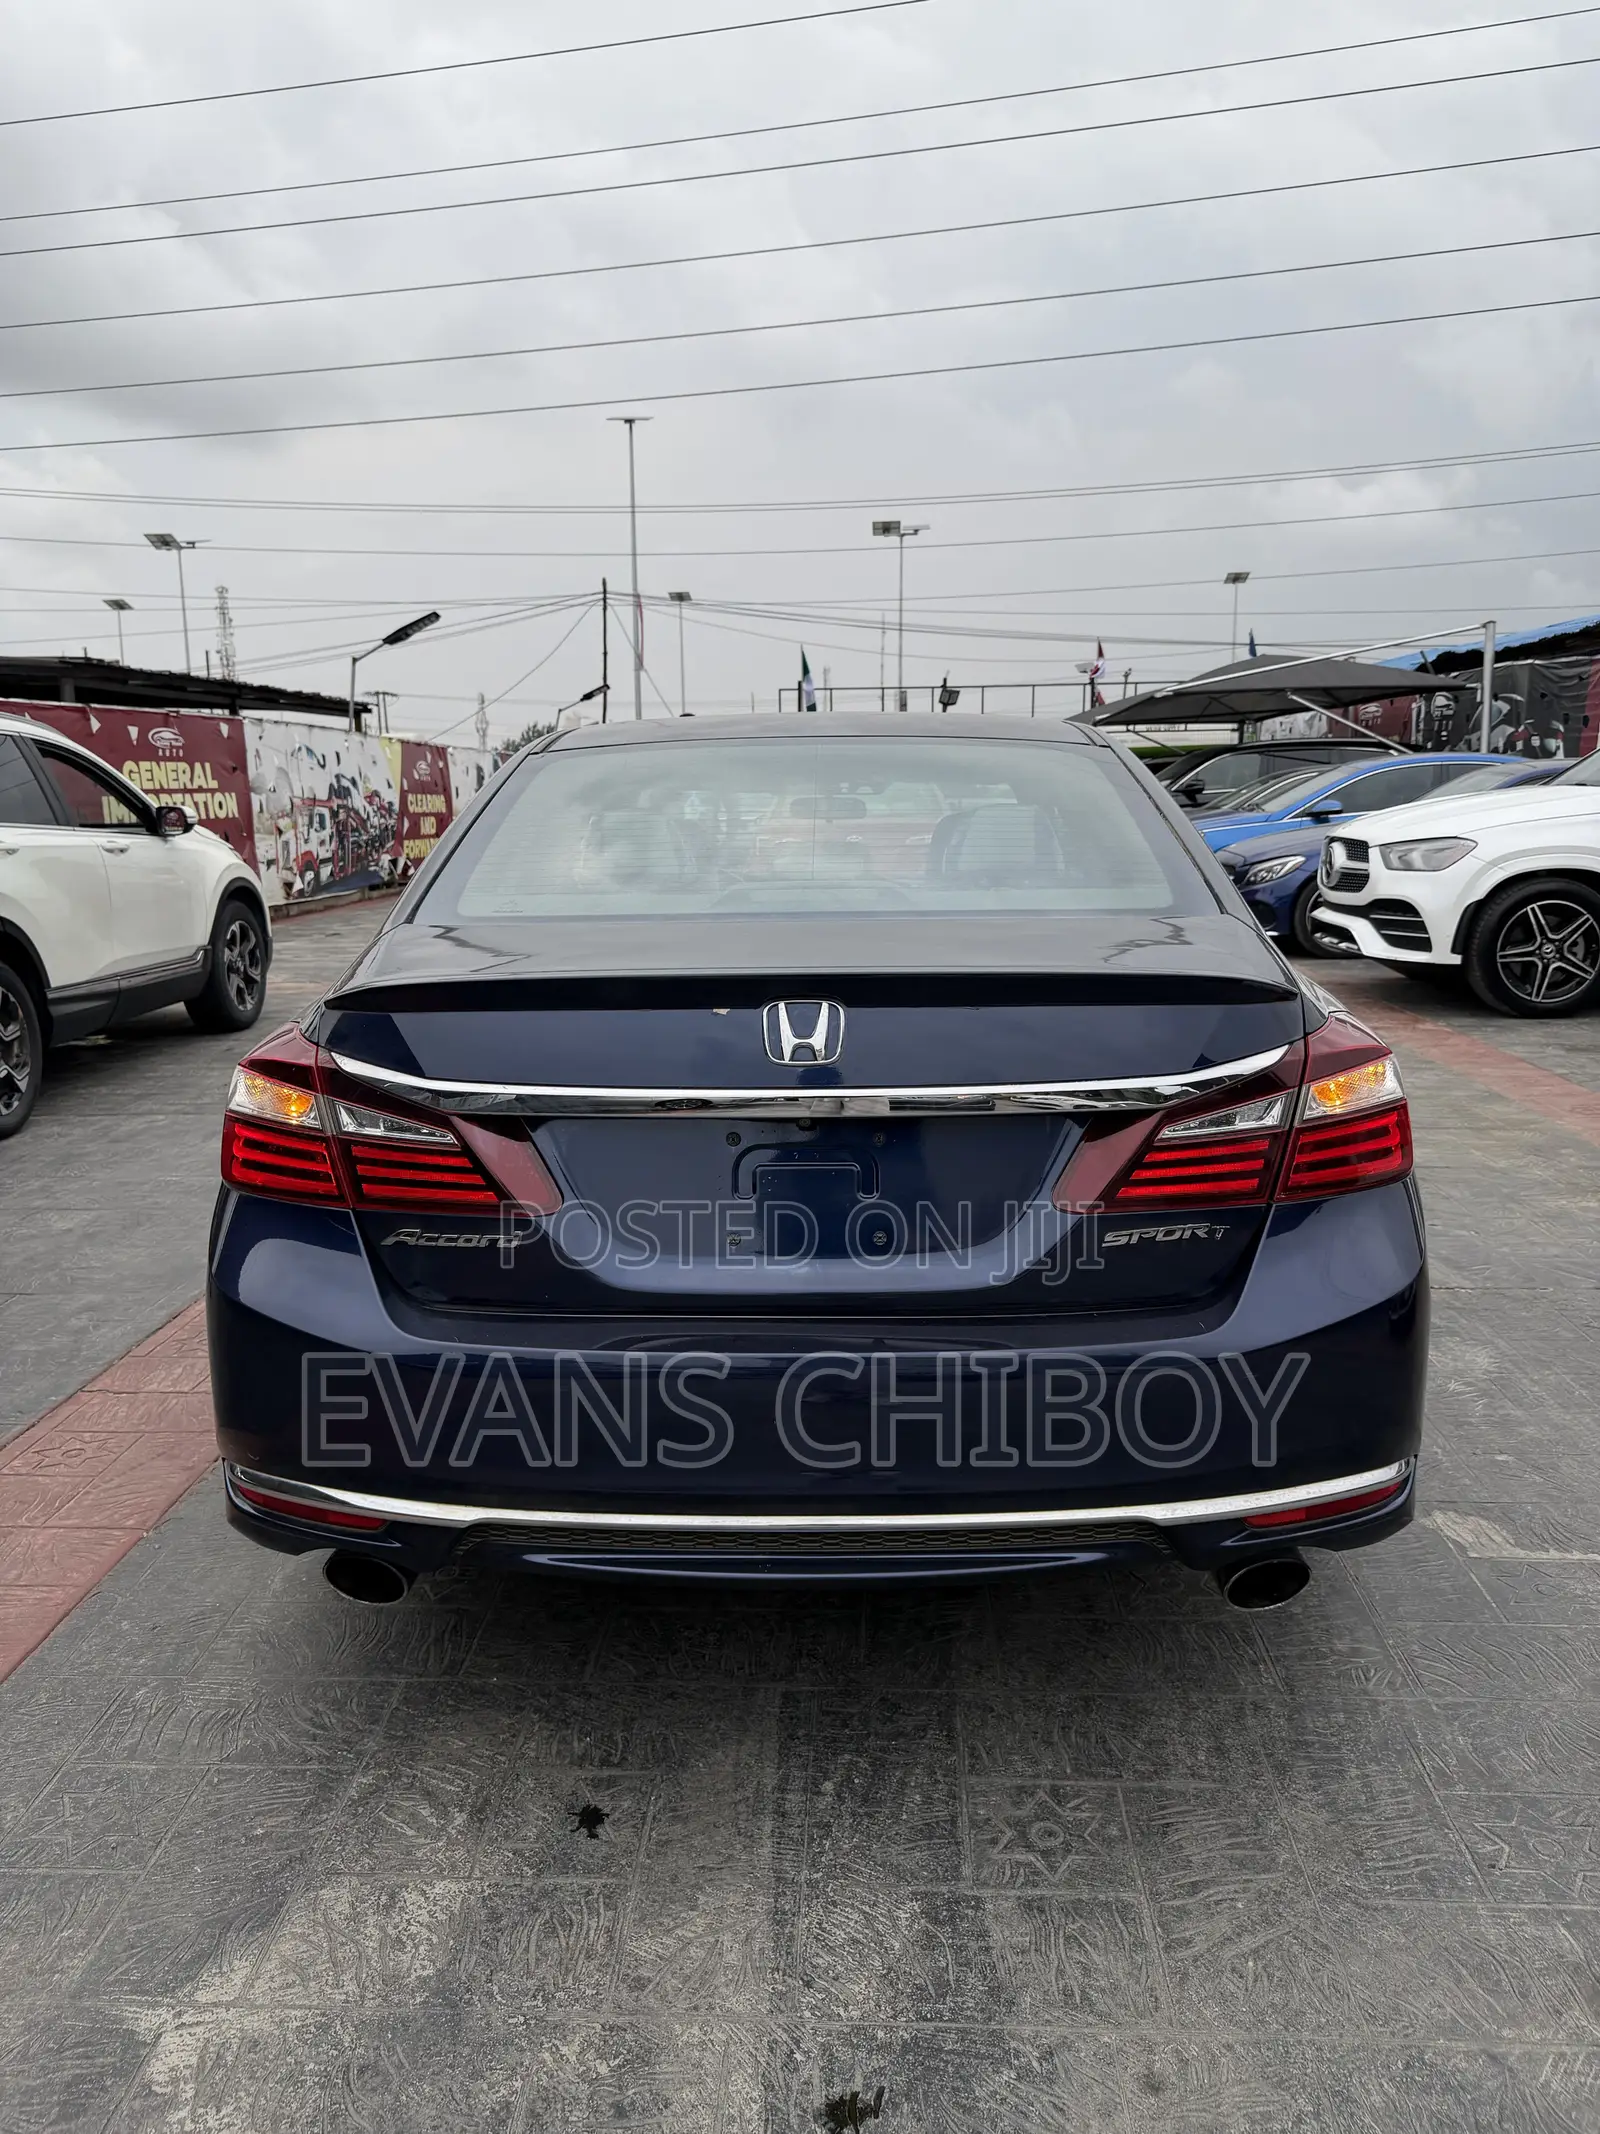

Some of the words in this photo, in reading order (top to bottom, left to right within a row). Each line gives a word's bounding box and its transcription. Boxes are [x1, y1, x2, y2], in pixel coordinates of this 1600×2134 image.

[158, 749, 183, 757] AUTO
[122, 760, 219, 790] GENERAL
[101, 792, 239, 824] IMRTATION
[407, 793, 447, 813] CLEARING
[420, 816, 437, 835] AND
[403, 837, 440, 859] FORWA
[380, 1228, 524, 1249] Accord
[1101, 1223, 1231, 1248] SPORT
